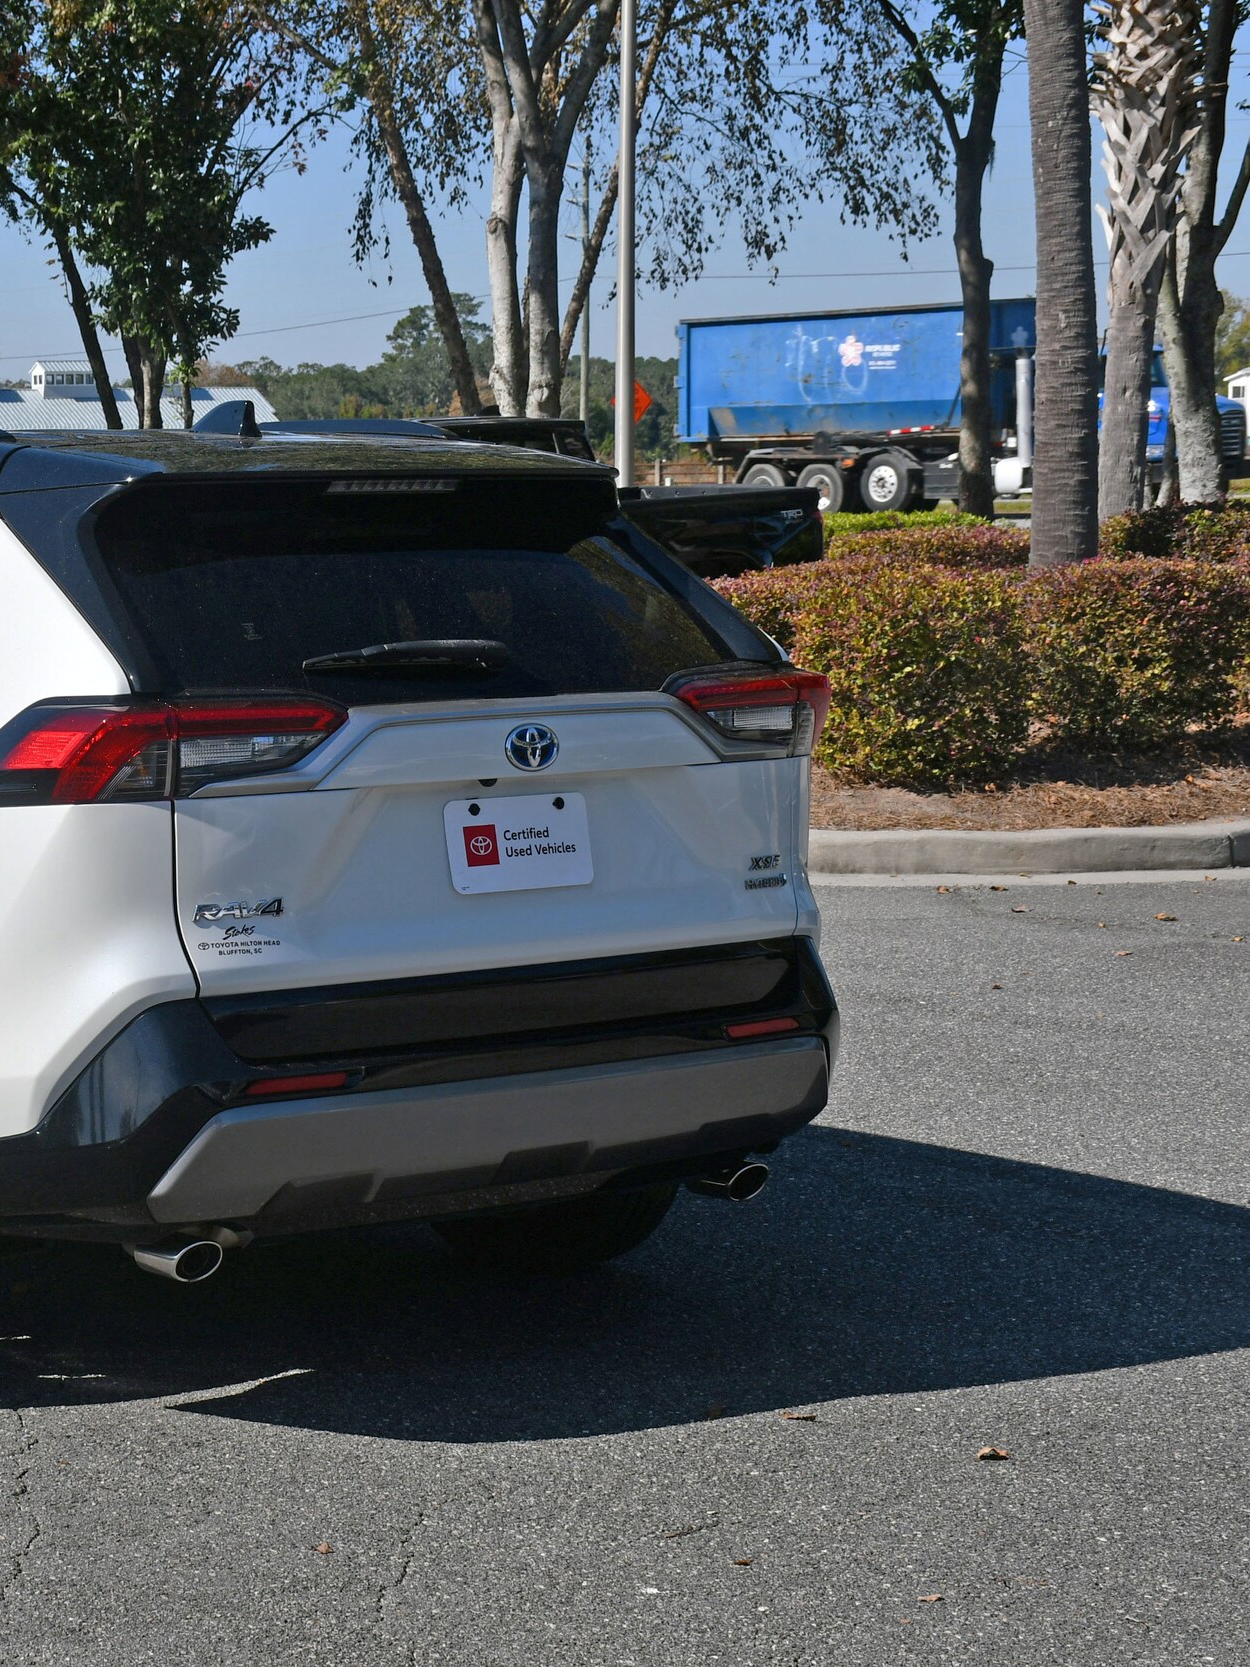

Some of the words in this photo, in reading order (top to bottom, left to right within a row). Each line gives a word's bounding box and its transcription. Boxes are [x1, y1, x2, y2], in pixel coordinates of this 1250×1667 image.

[780, 509, 803, 519] TRD
[503, 827, 550, 841] Certified
[505, 844, 533, 858] Used
[534, 842, 576, 855] Vehicles
[748, 854, 781, 871] XSE
[192, 897, 284, 922] RAV4
[222, 924, 256, 941] Stokes
[211, 941, 239, 949] TOYOTA
